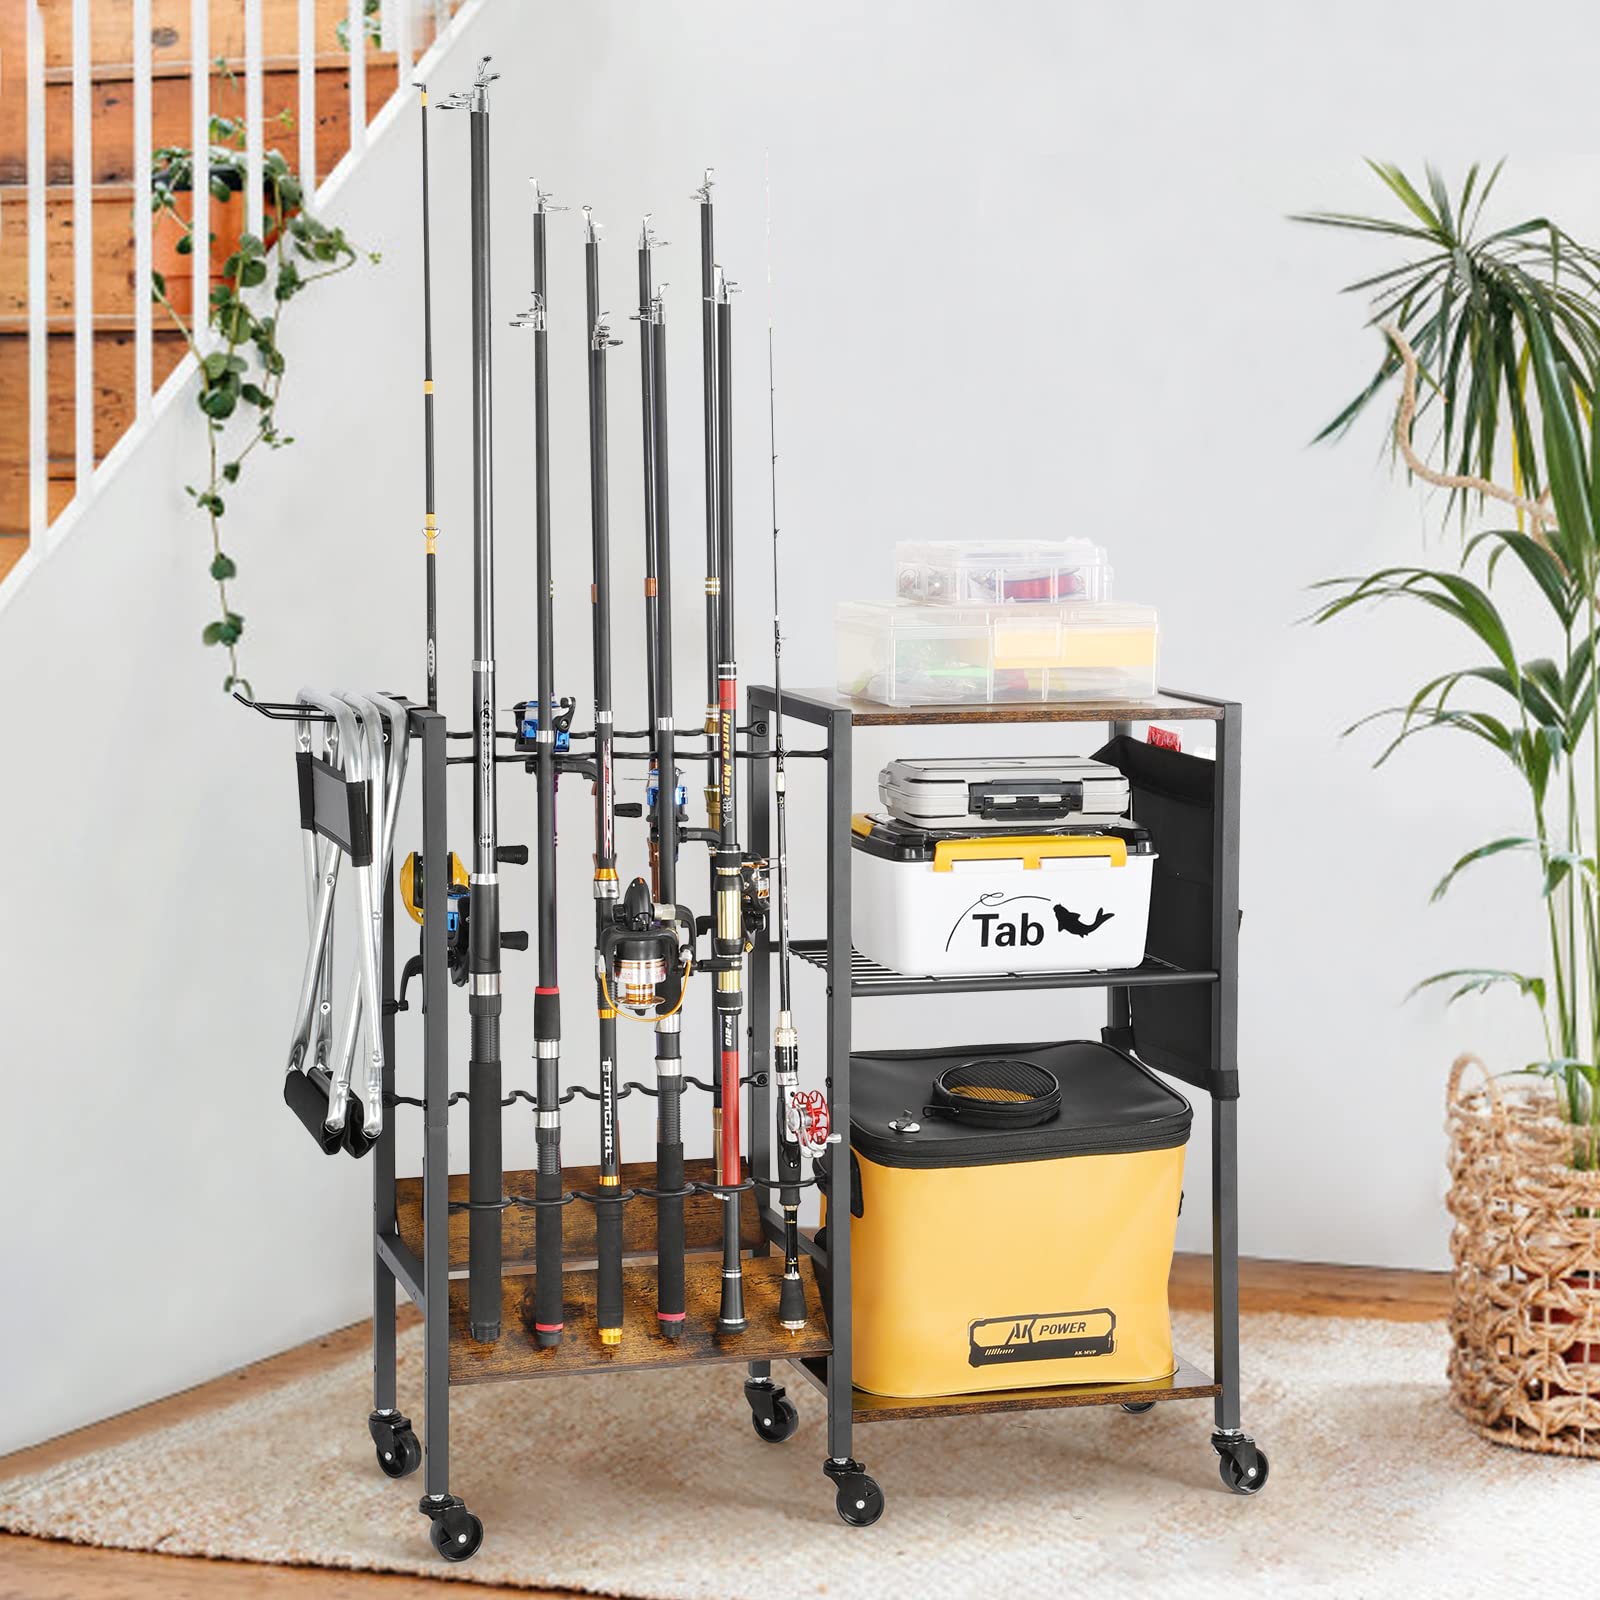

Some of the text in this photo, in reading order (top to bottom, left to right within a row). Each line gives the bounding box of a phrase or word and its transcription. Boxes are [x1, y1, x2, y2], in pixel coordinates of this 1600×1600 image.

[723, 764, 732, 796] Man
[972, 912, 1045, 947] Tab
[1005, 1319, 1087, 1345] AK POWER
